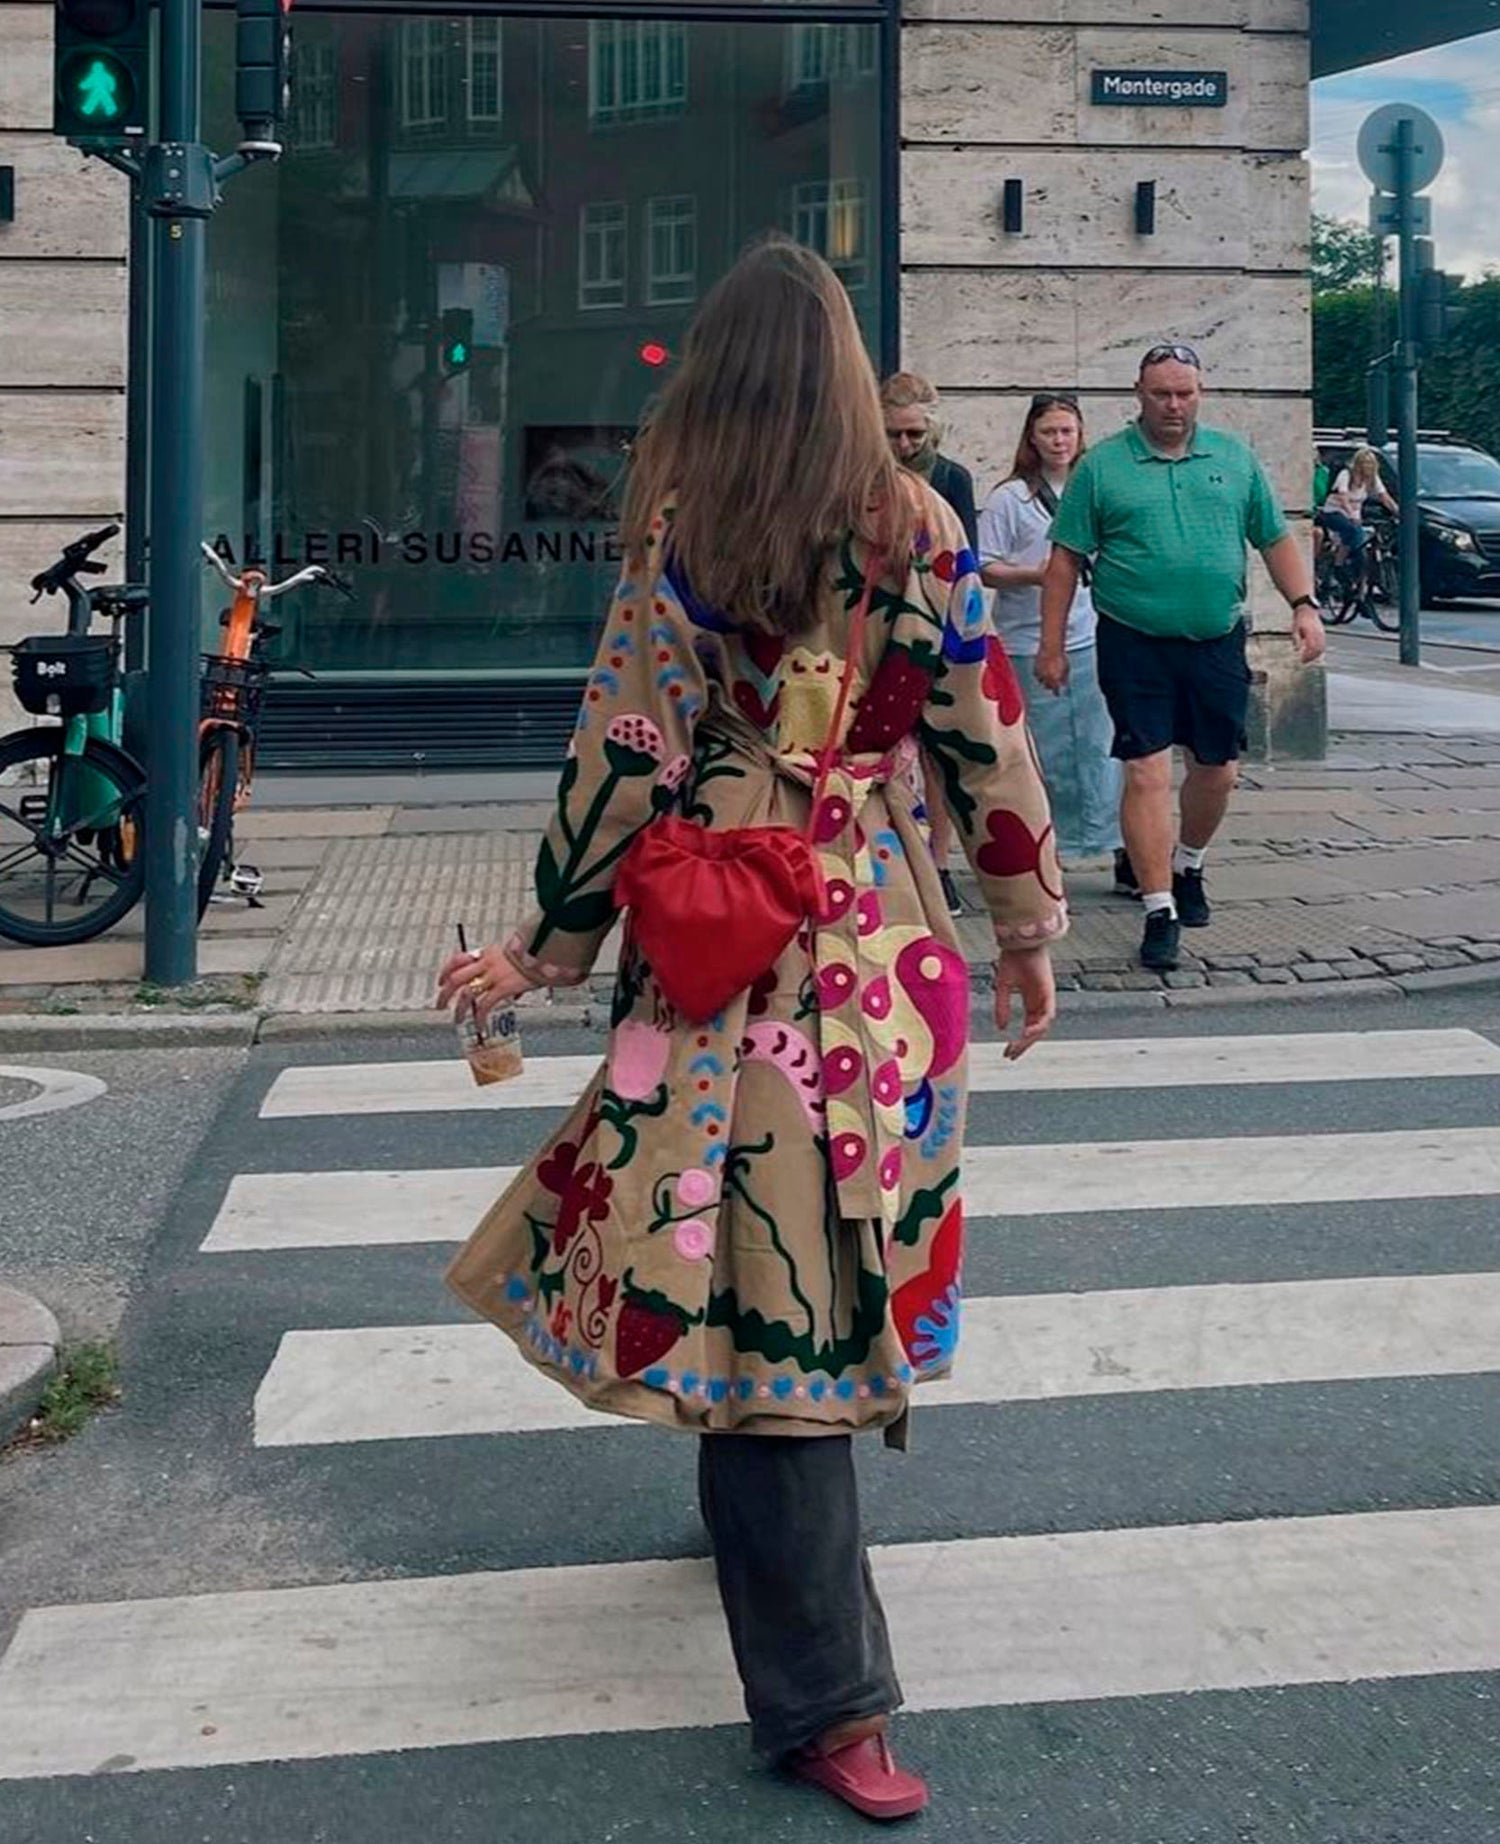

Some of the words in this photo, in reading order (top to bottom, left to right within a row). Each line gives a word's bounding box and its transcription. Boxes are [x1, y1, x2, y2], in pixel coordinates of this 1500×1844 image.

[1103, 76, 1217, 99] Møntergade
[206, 533, 379, 565] ALLERI
[402, 532, 623, 564] SUSANNE
